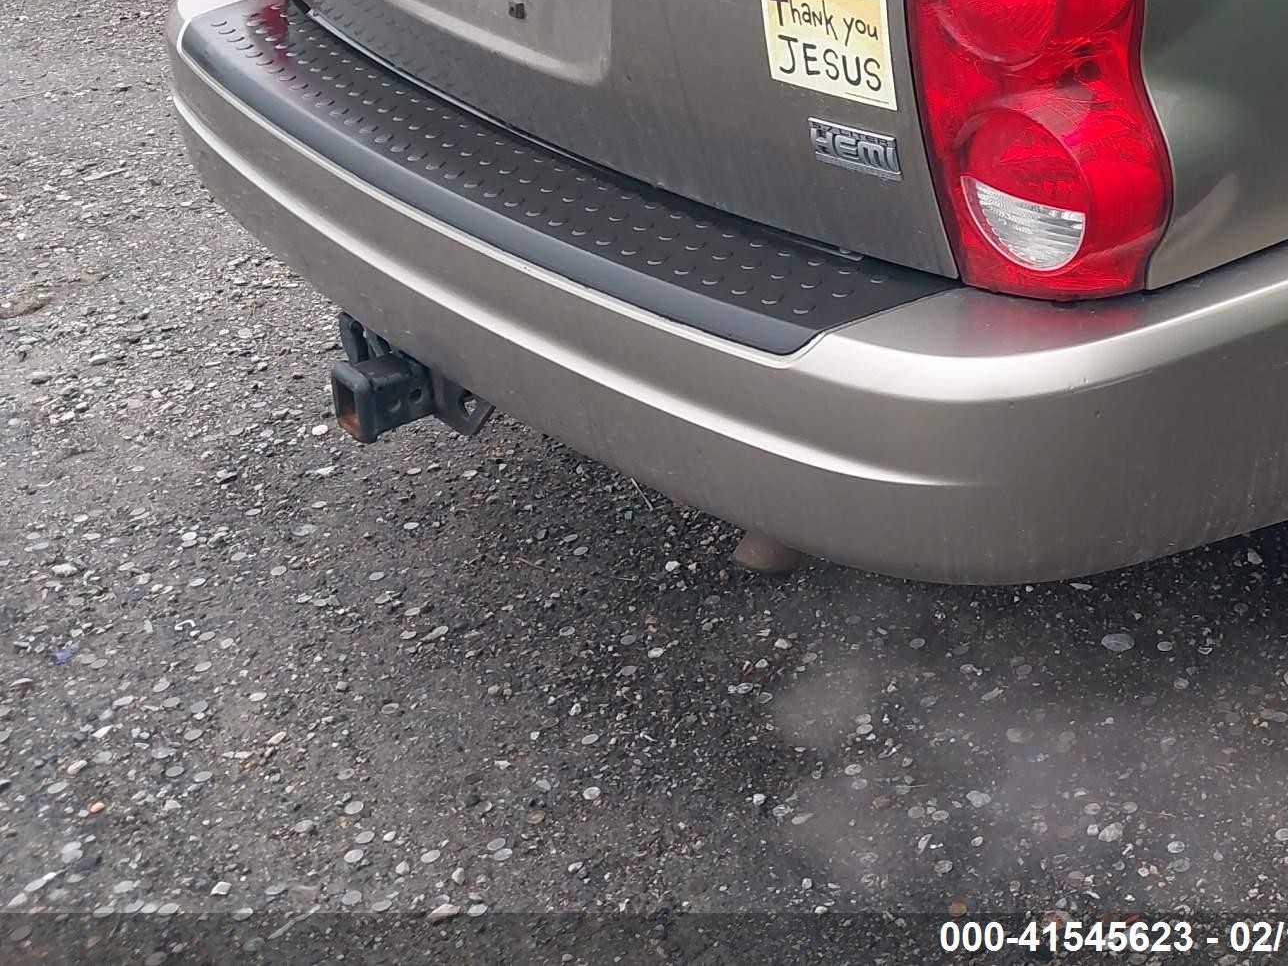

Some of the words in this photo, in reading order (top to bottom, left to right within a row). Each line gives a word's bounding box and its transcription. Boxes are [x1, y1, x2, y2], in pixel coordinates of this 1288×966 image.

[843, 16, 879, 47] you
[777, 34, 882, 92] JESUS
[810, 127, 900, 173] HEMI
